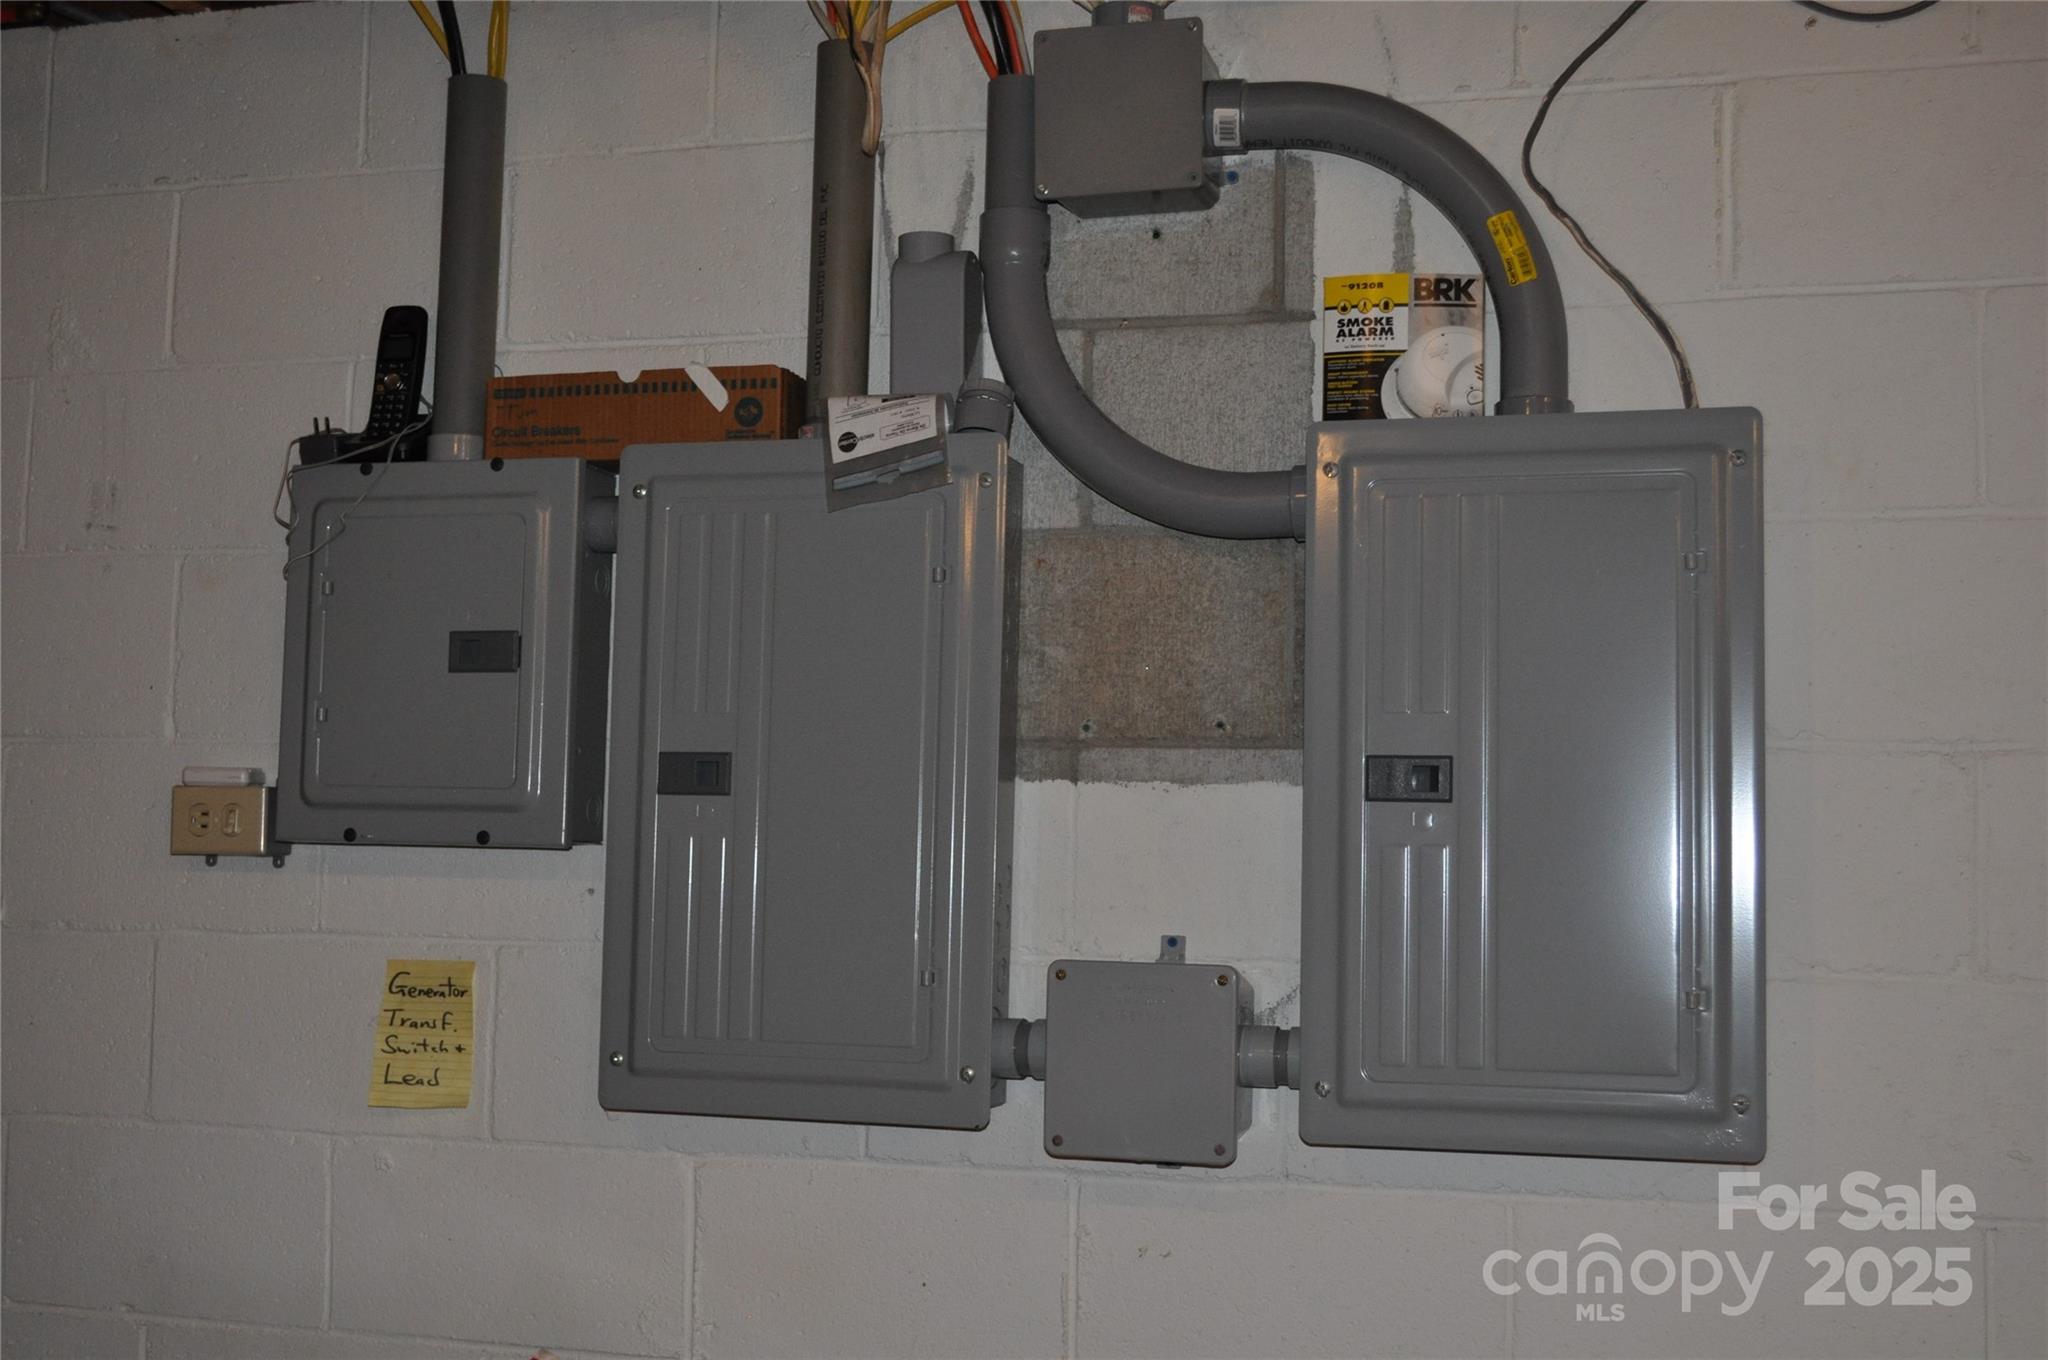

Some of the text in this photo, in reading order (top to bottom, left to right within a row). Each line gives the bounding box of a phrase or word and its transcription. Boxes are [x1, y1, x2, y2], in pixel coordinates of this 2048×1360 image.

[1414, 278, 1477, 302] BRK
[1336, 327, 1394, 338] ALARM
[1337, 317, 1394, 328] SMOKE
[492, 425, 581, 438] Circuit Breakers
[388, 970, 468, 998] Generator
[381, 1033, 449, 1054] Switch
[383, 1062, 441, 1088] Lead
